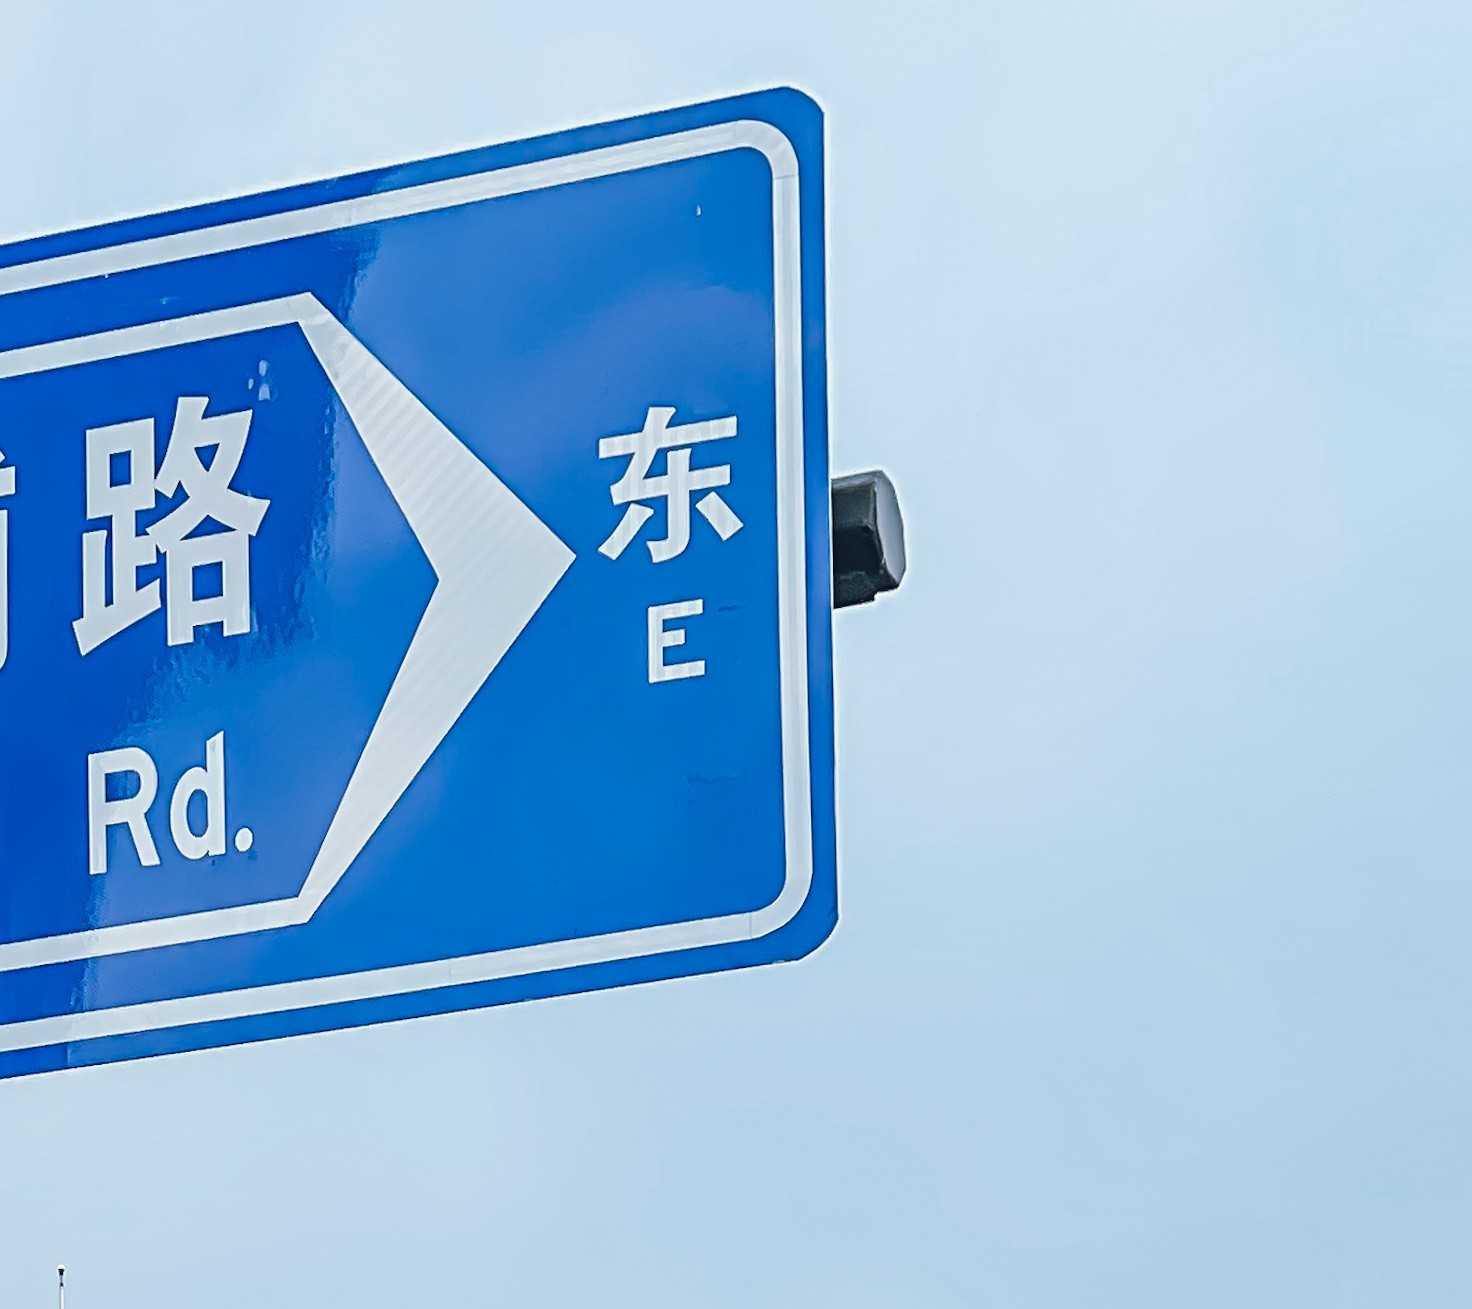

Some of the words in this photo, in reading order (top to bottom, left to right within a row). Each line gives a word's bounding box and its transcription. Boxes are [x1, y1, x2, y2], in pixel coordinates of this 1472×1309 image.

[597, 406, 744, 564] 东
[647, 599, 706, 685] E
[86, 730, 255, 877] Rd.
